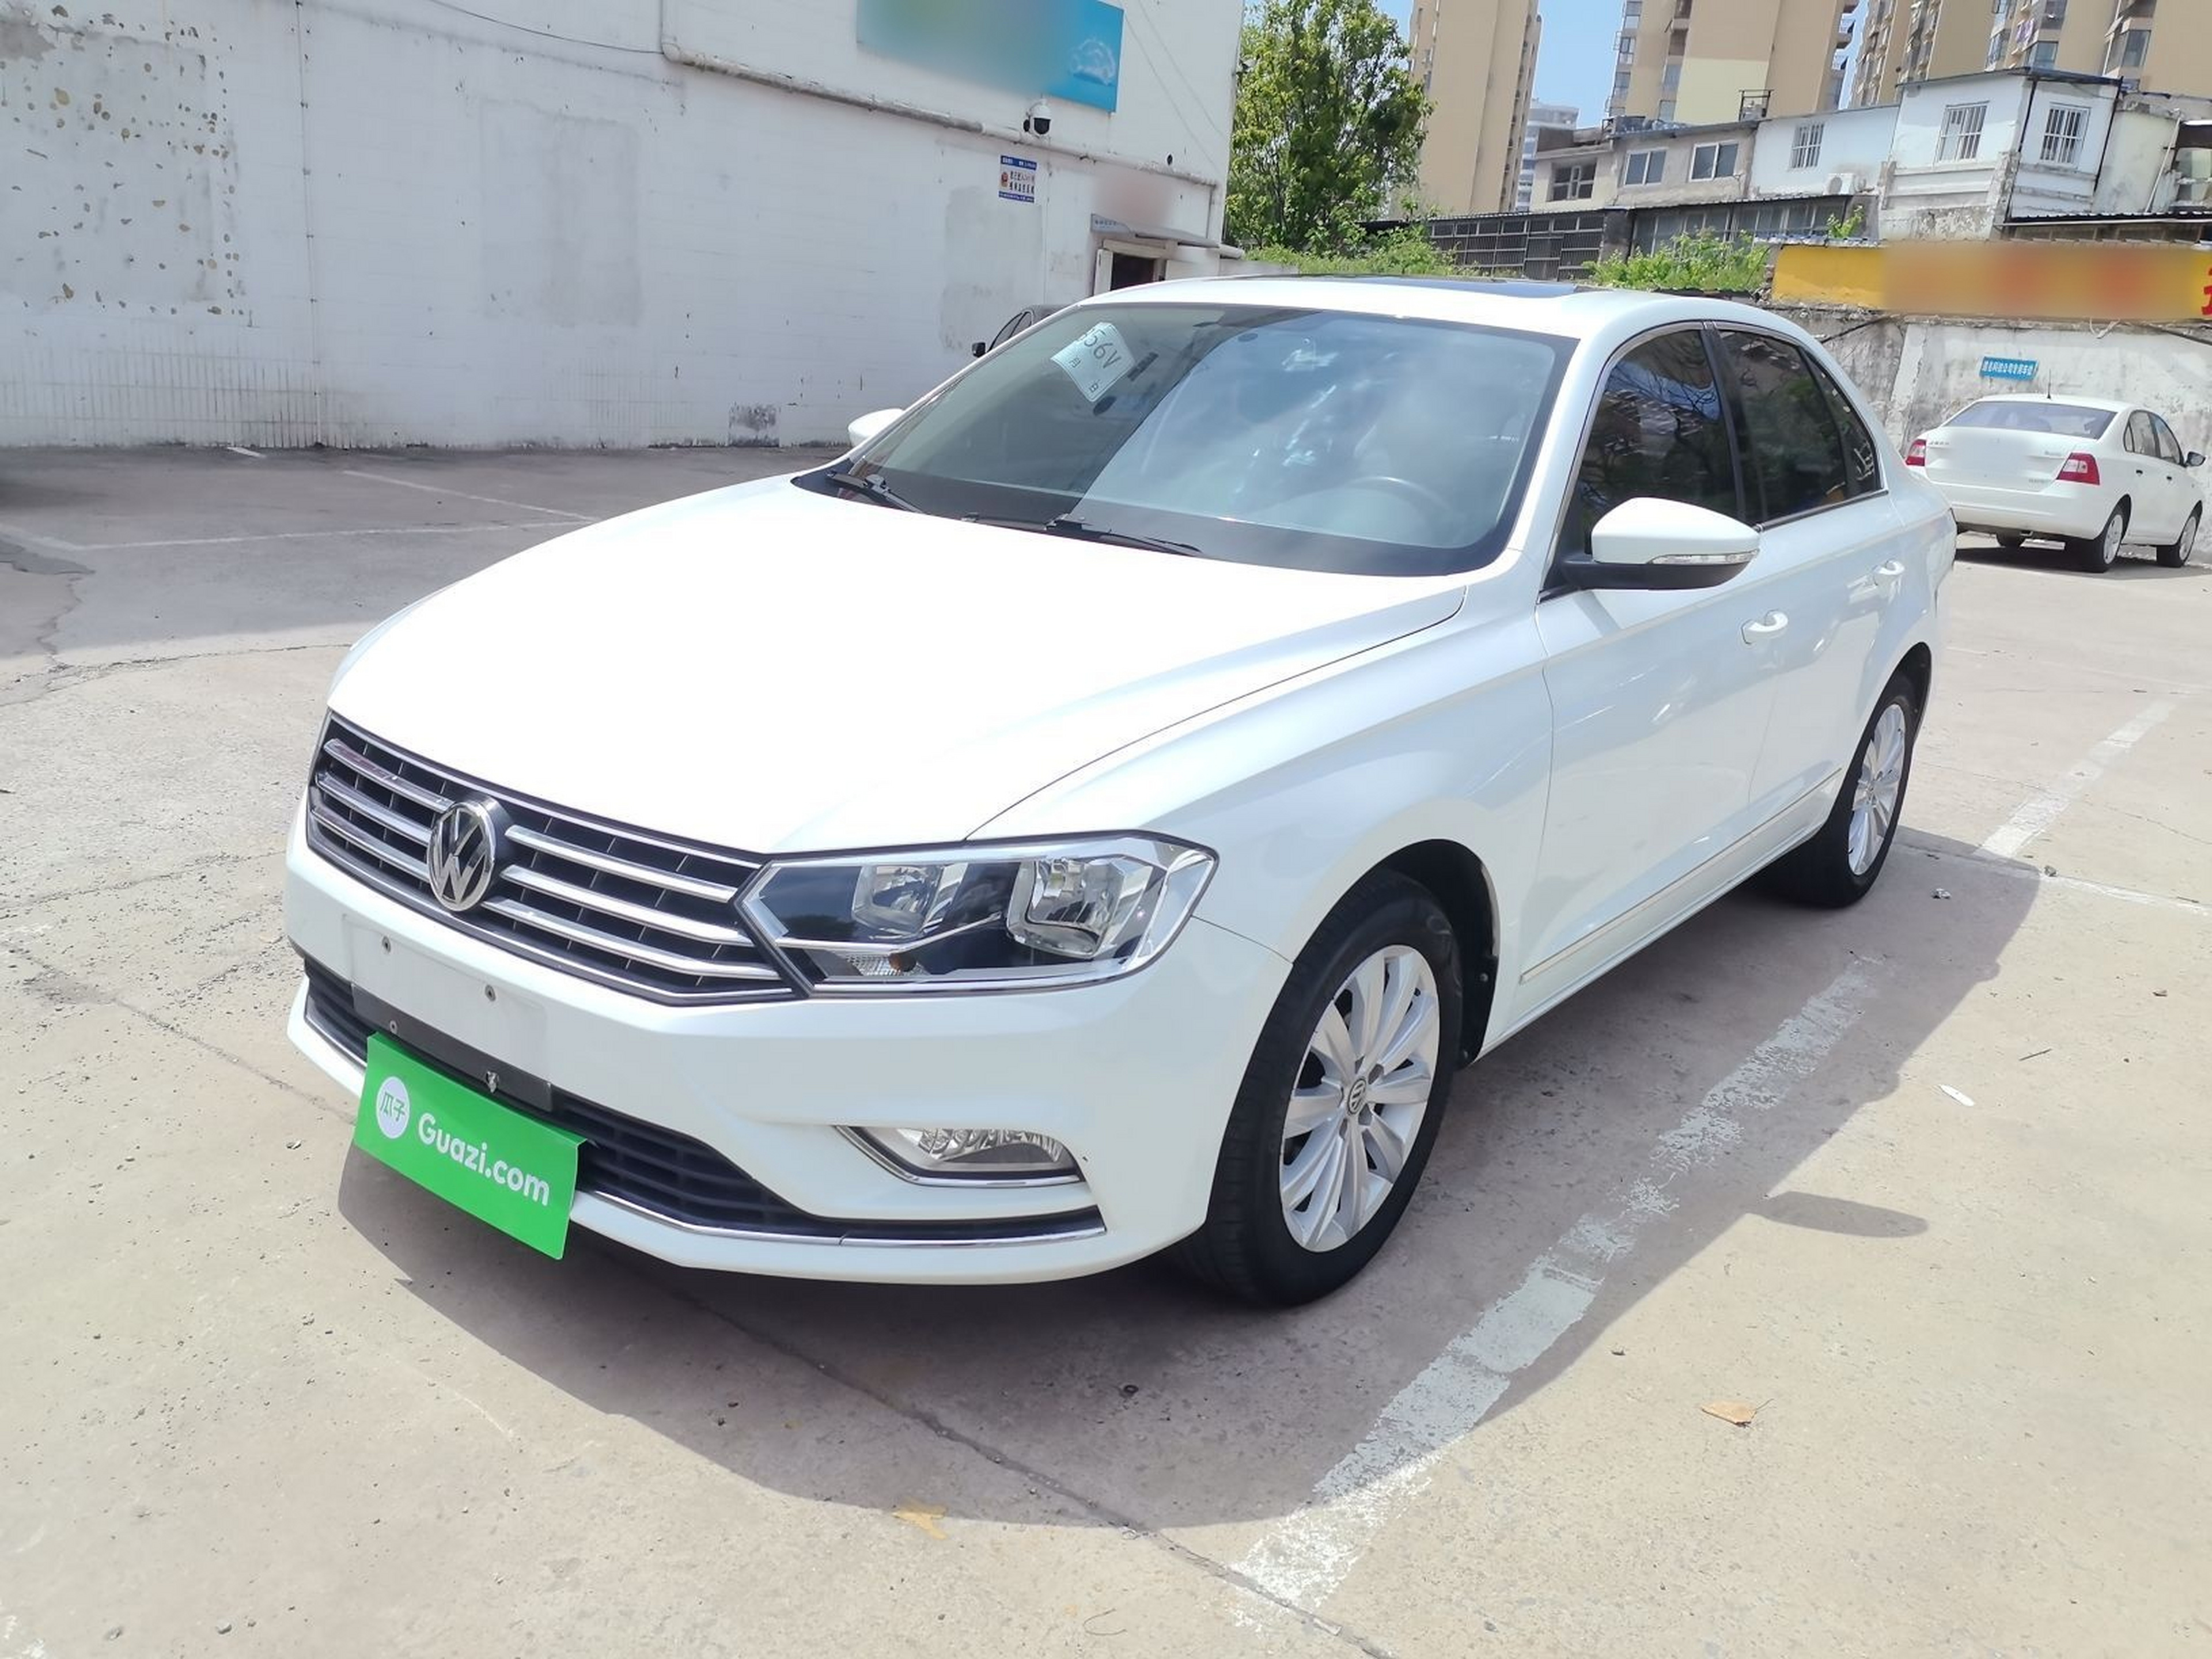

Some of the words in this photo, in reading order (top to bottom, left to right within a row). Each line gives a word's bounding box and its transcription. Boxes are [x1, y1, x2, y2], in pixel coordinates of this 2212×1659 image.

[1079, 328, 1122, 369] 56V
[380, 1091, 406, 1122] 瓜子
[418, 1112, 550, 1206] Guazi.com
